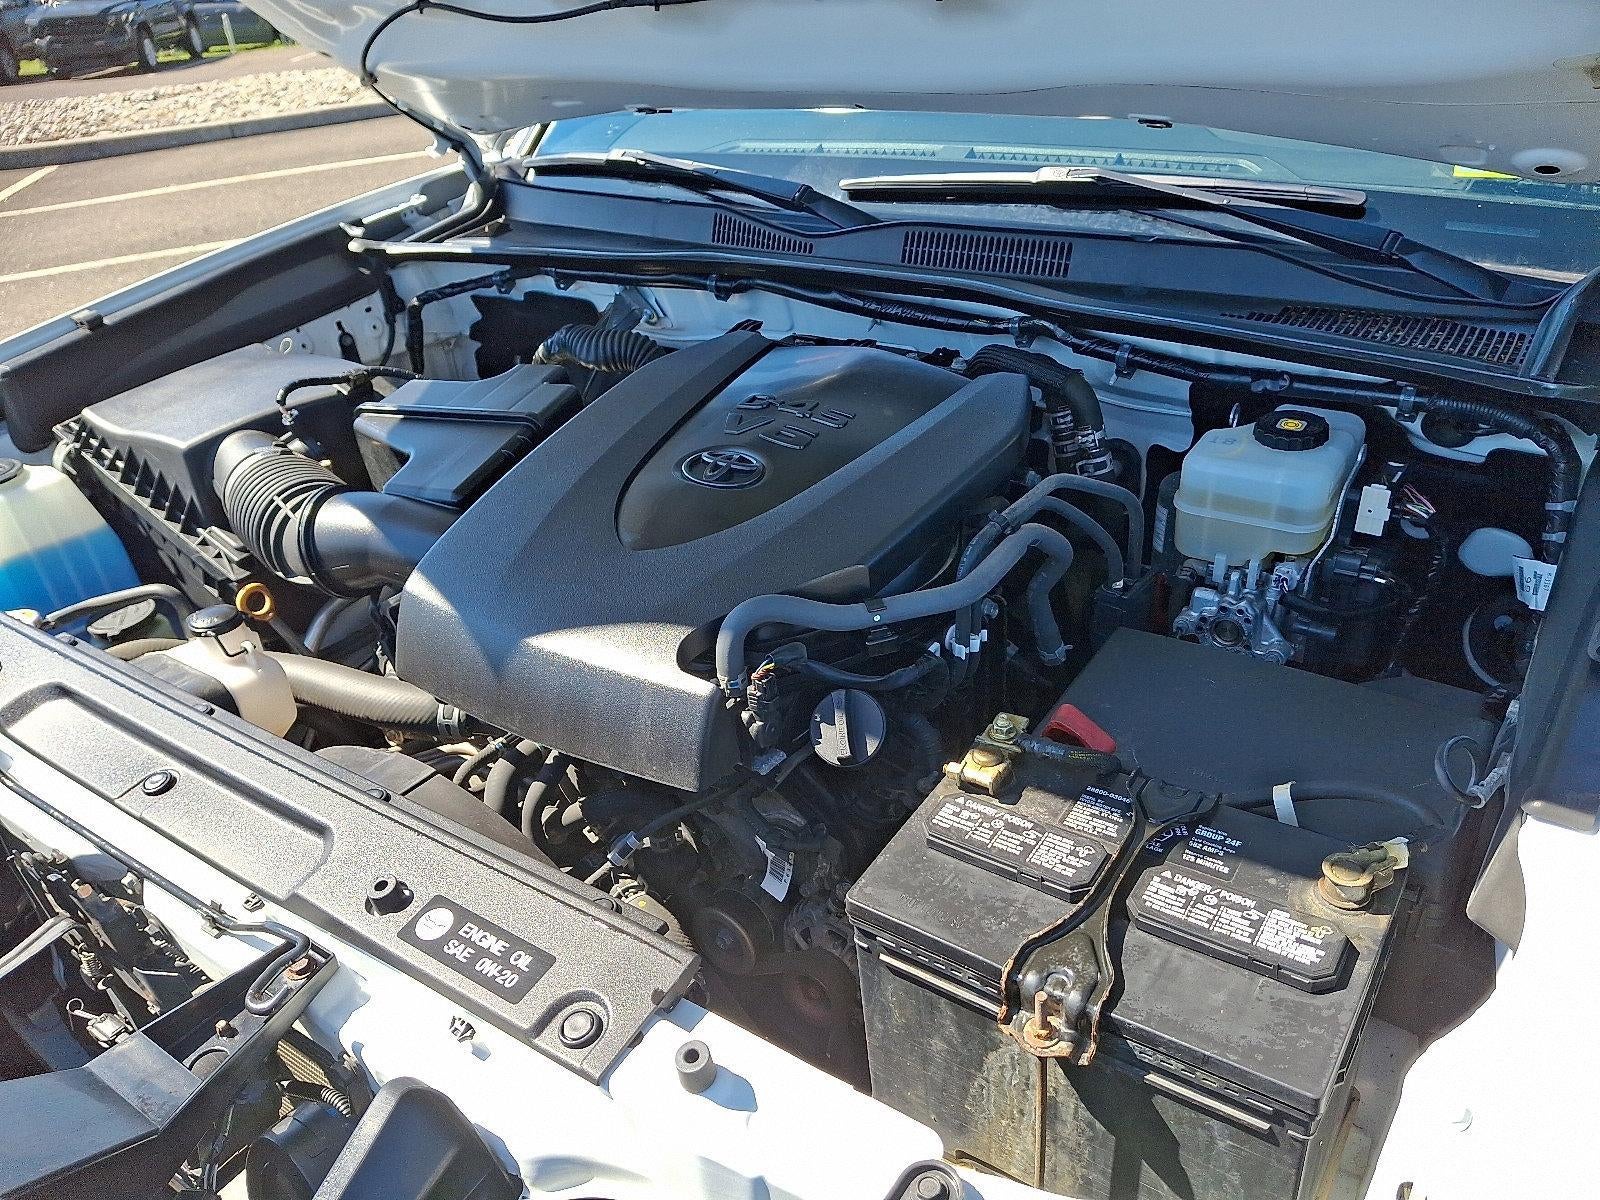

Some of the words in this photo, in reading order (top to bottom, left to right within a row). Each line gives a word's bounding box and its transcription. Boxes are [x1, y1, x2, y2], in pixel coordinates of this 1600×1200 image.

[964, 799, 998, 816] DANGER
[1003, 813, 1034, 829] POISON
[1194, 828, 1224, 841] GROUP
[1224, 837, 1242, 847] 24F
[1202, 845, 1225, 857] AMPS
[1195, 857, 1230, 874] MINUTES
[1173, 872, 1212, 893] DANGER
[1220, 890, 1257, 908] POISON
[457, 922, 510, 956] ENGINE
[509, 950, 534, 972] OIL
[443, 939, 475, 963] SAE
[474, 957, 519, 988] 0W-20
